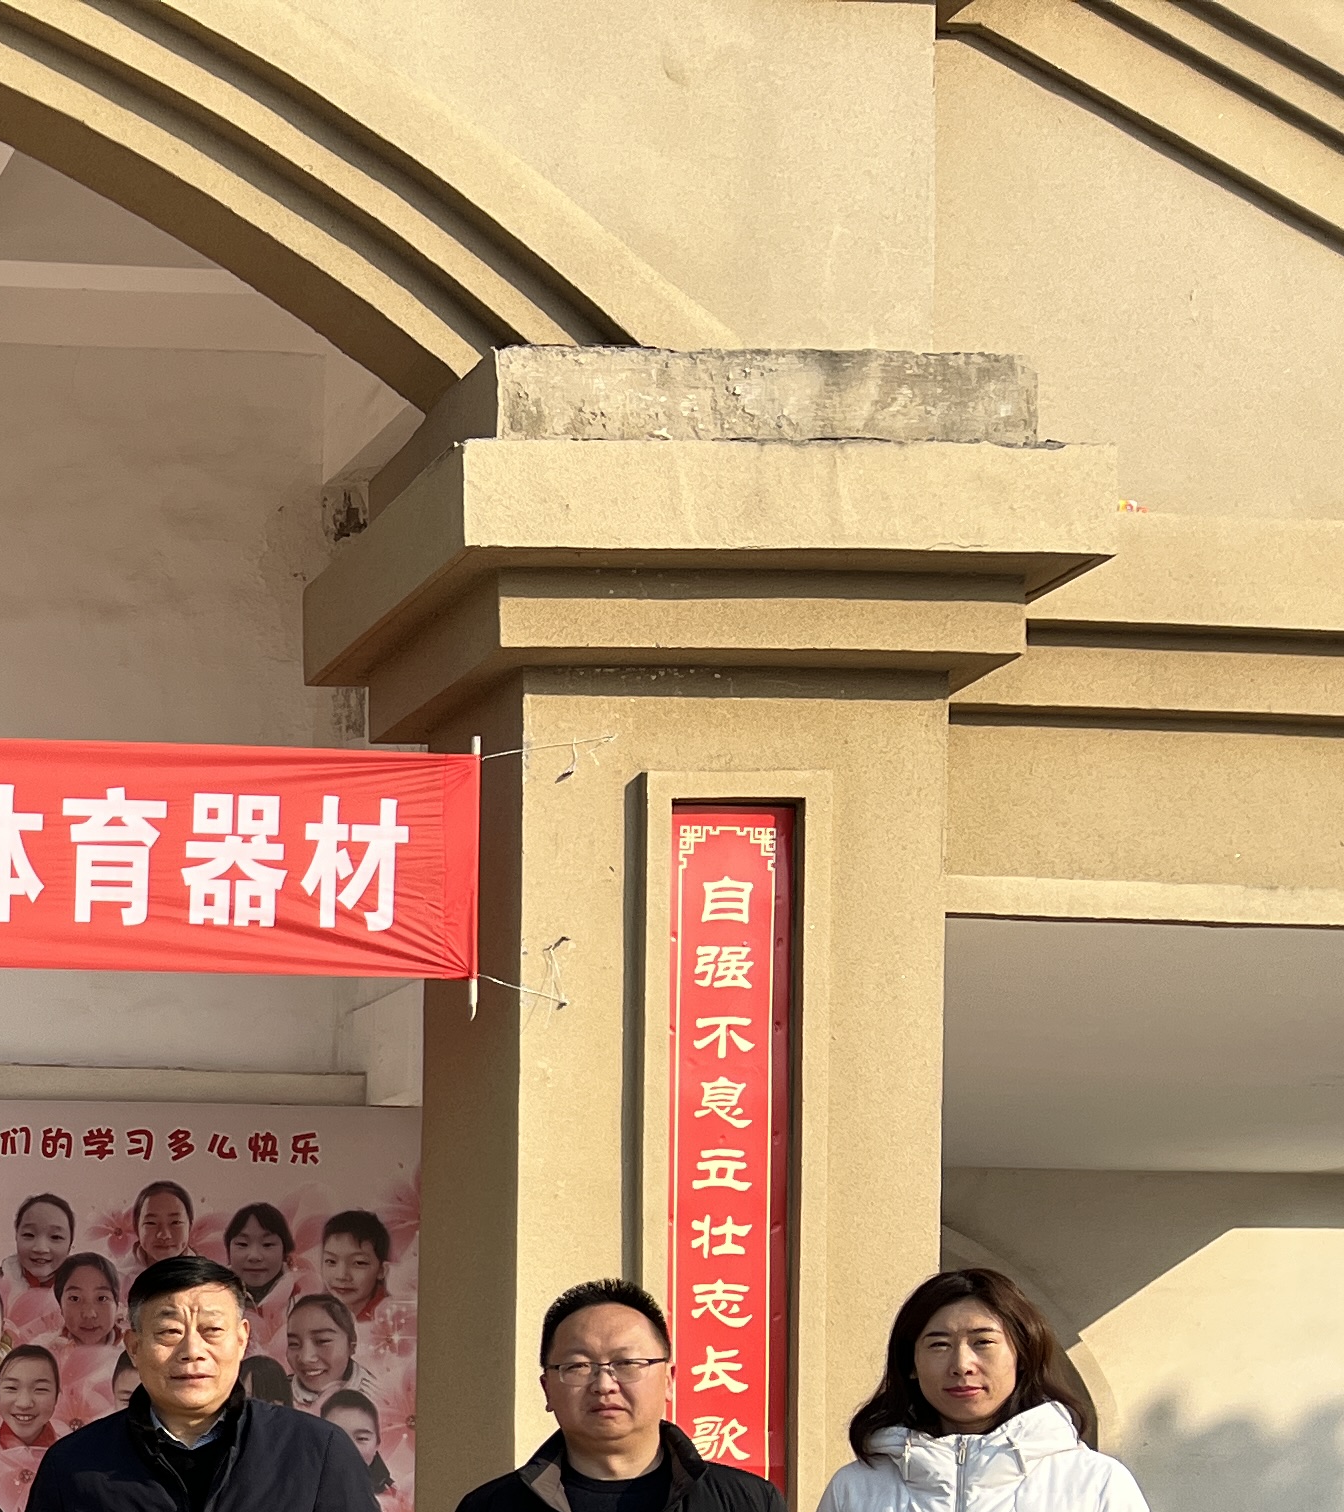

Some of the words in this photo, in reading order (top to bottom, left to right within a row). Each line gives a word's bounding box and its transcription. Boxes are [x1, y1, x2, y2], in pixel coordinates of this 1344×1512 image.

[691, 876, 755, 1461] 自强不息立壮志长歌
